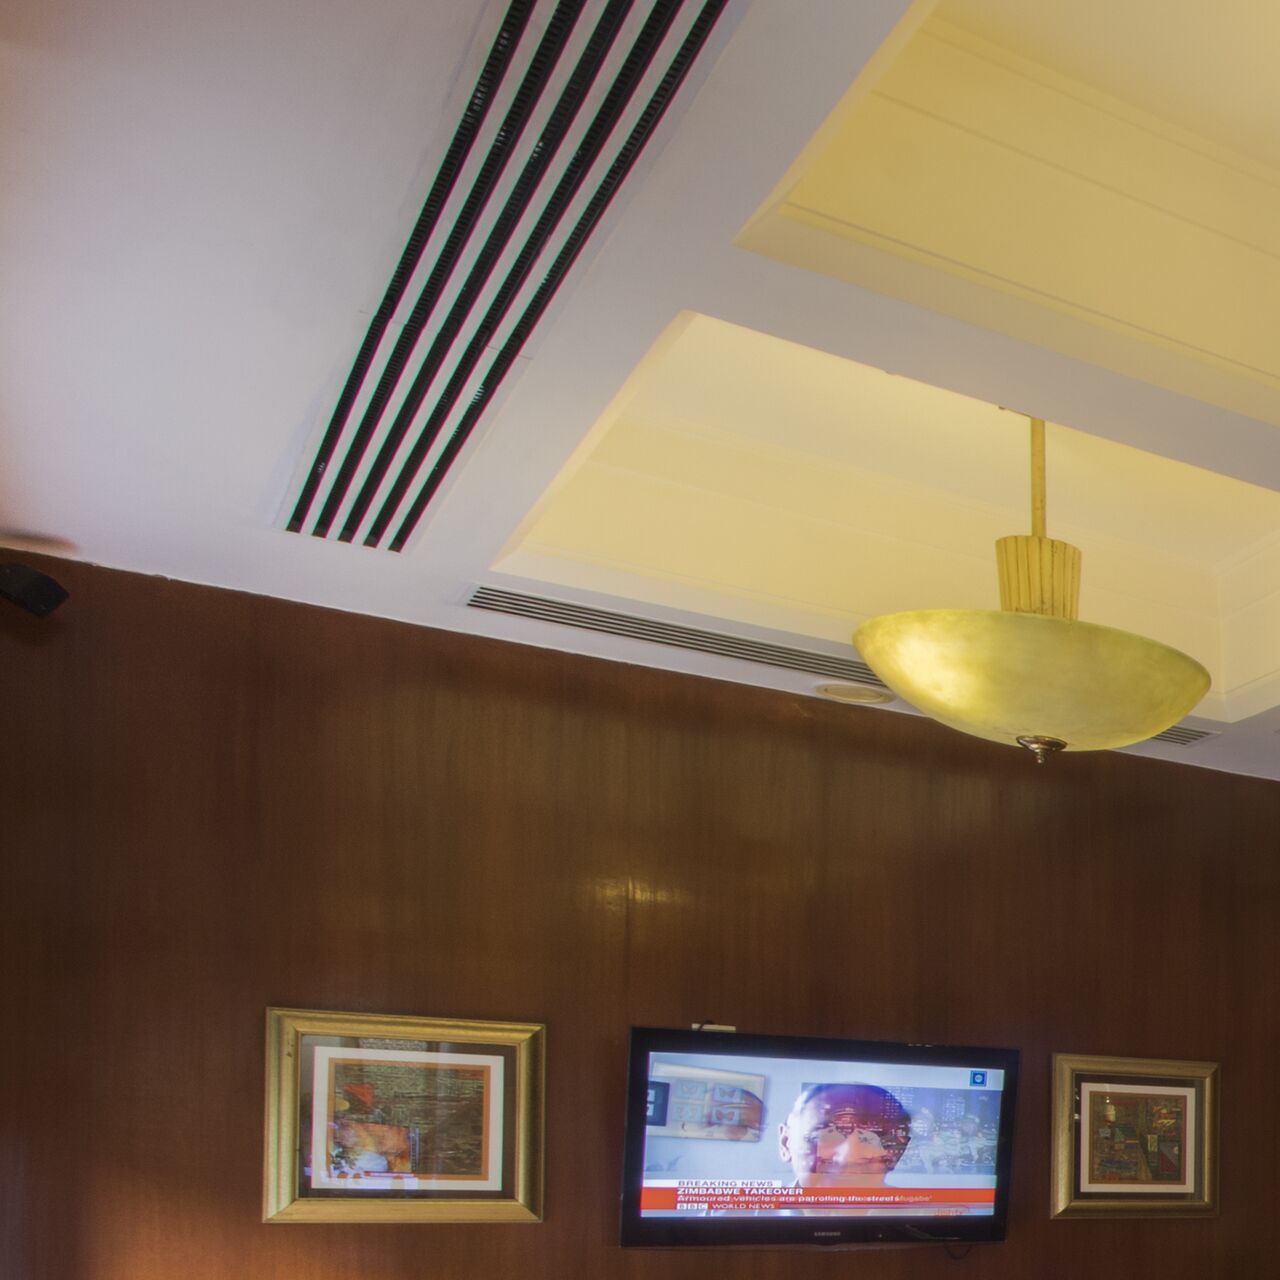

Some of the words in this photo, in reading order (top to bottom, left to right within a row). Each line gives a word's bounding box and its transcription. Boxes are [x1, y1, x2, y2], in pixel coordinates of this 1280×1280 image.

[677, 1180, 739, 1188] BREAKING
[740, 1180, 774, 1188] NEWS
[677, 1187, 741, 1195] ZIMBABWE
[743, 1187, 804, 1195] TAKEOVER
